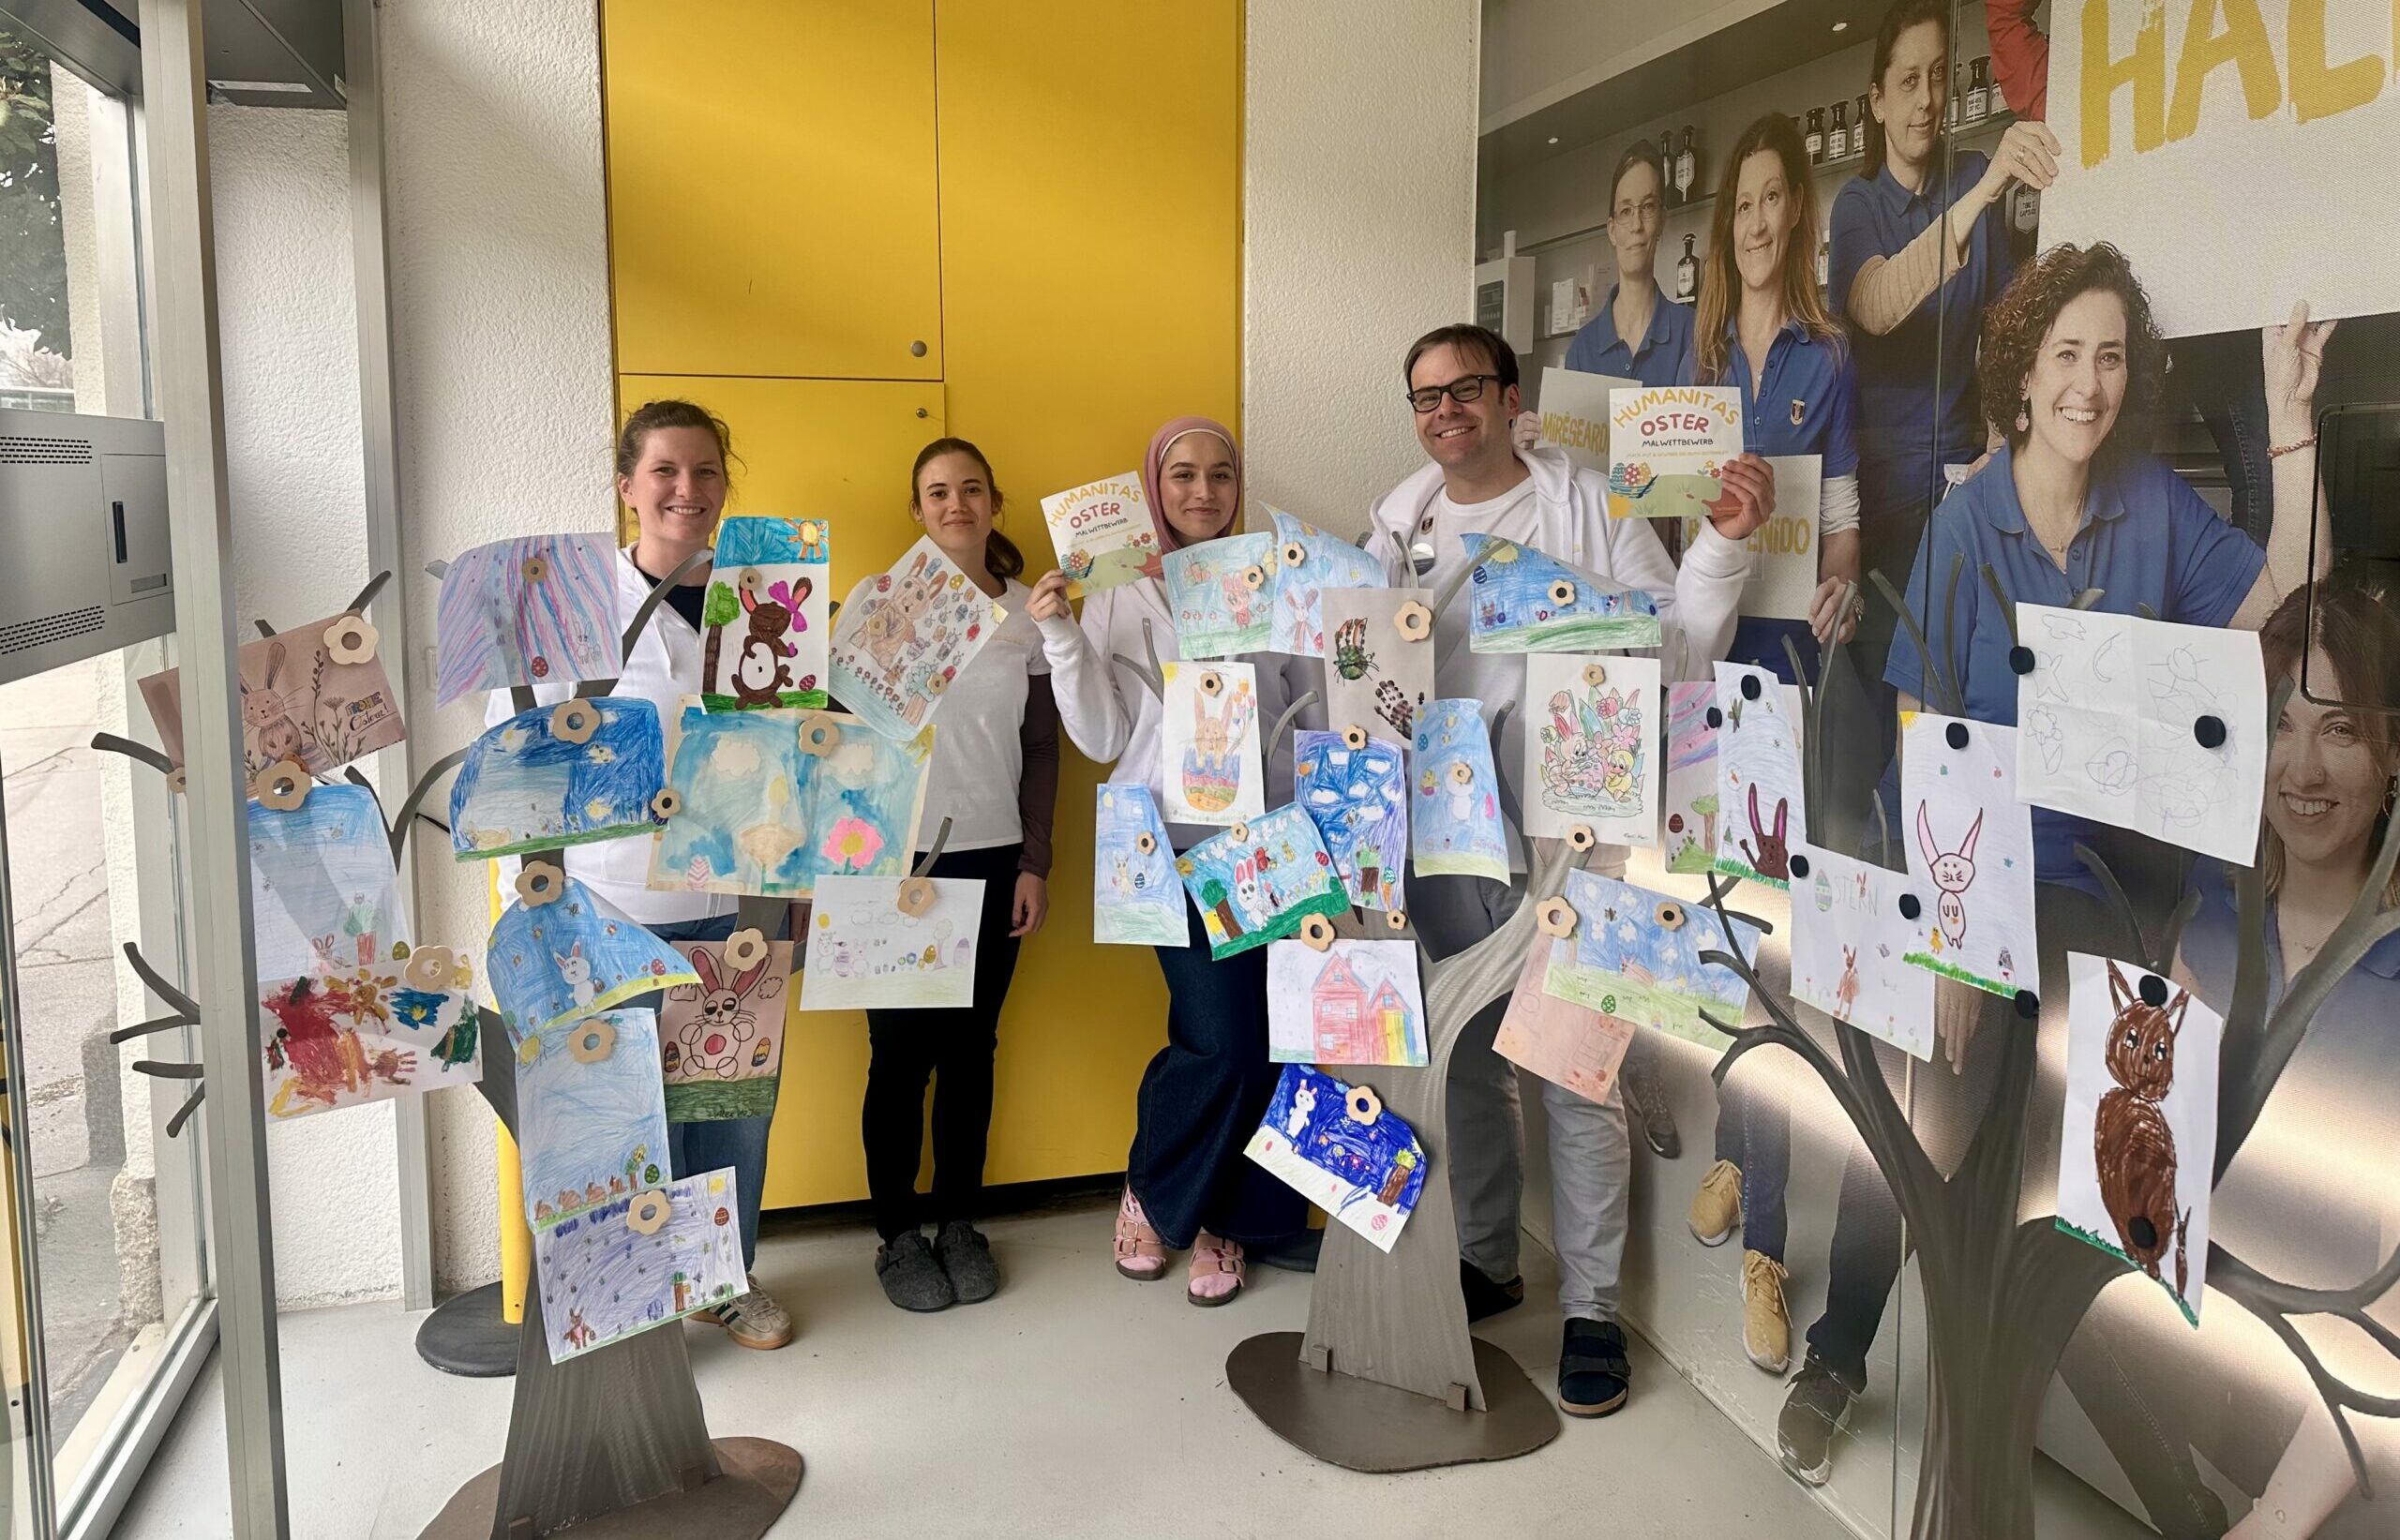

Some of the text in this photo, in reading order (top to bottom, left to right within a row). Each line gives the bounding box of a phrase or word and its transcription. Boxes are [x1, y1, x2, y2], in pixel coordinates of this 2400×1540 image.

[2080, 0, 2400, 170] HAL
[1613, 388, 1739, 428] HUMANITAS
[1641, 413, 1709, 436] OSTER
[1642, 438, 1714, 447] MALWETTBEWERB
[1048, 482, 1141, 528] HUMANITAS
[1070, 501, 1120, 529] OSTER
